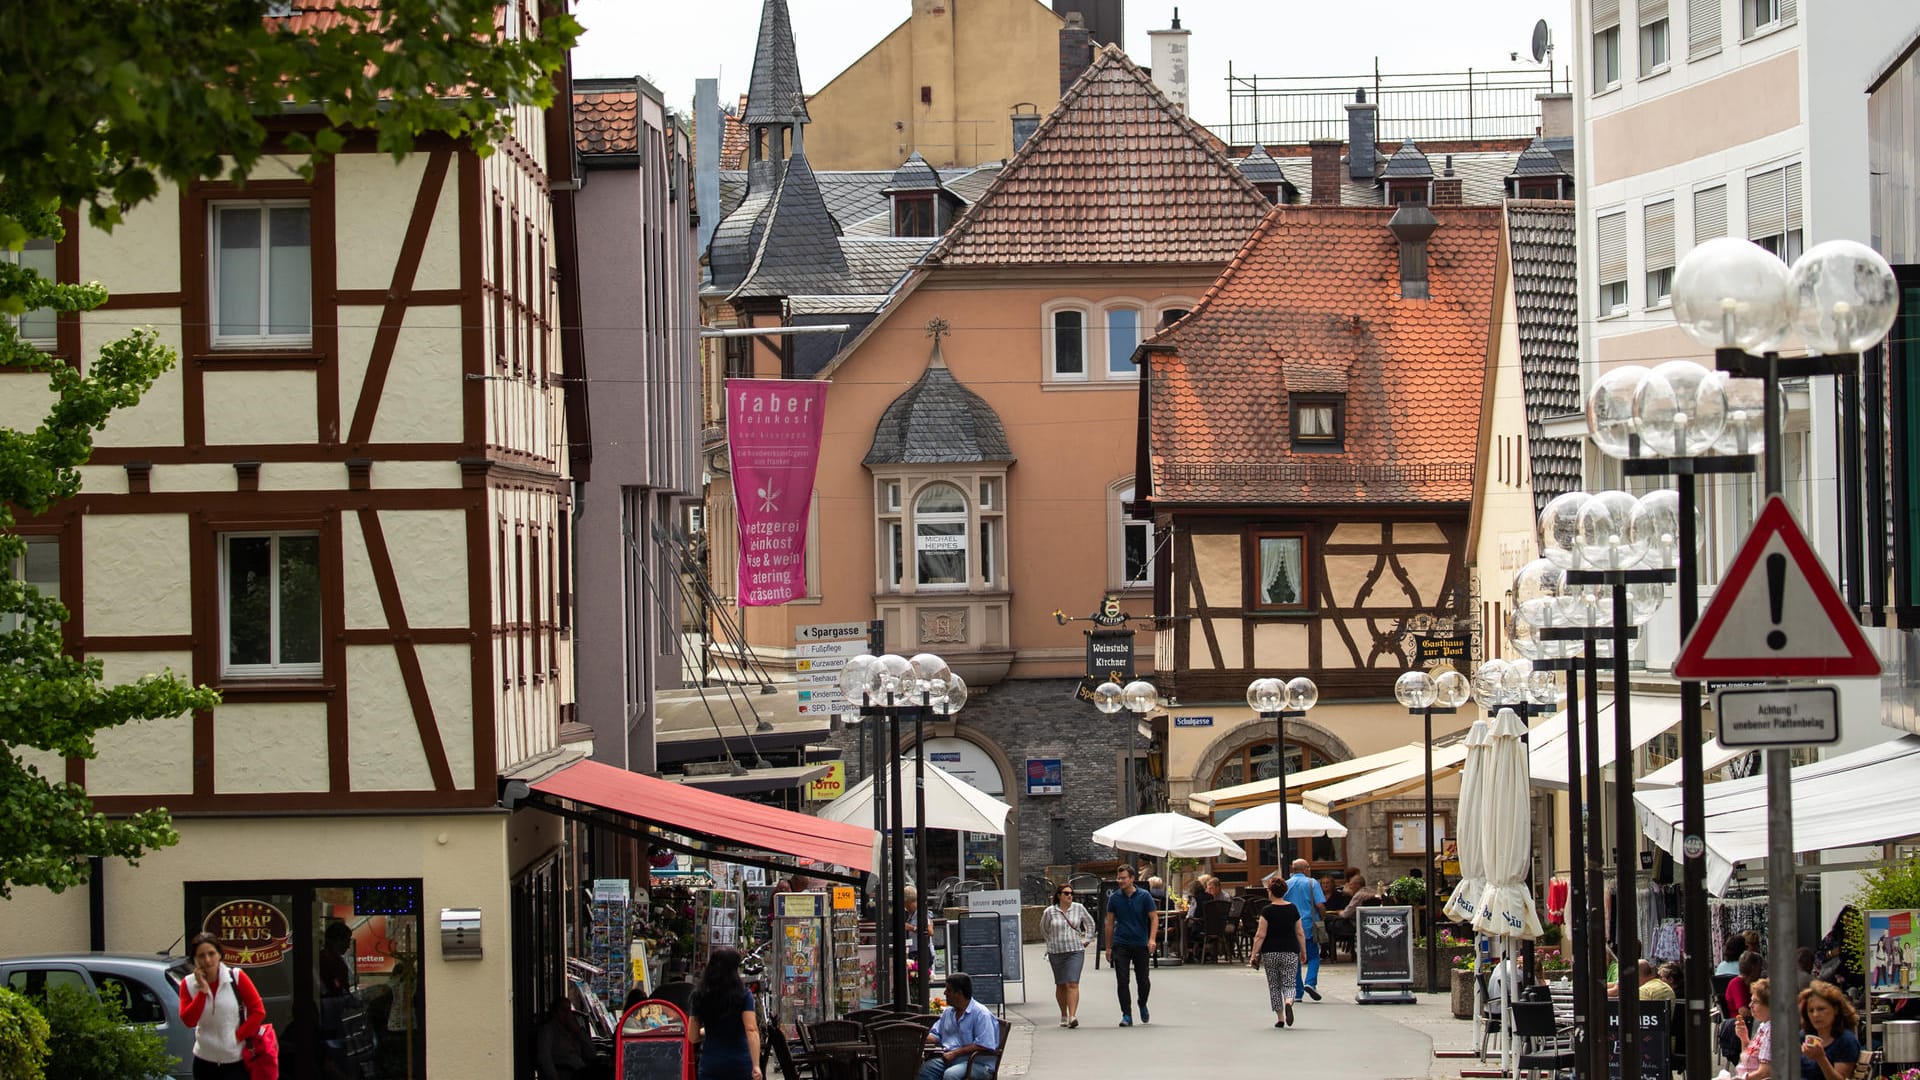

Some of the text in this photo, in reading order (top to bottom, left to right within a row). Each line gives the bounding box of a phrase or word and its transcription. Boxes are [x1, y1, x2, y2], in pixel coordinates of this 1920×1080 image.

[739, 392, 813, 413] faber
[739, 414, 807, 424] feinkost
[763, 552, 771, 567] &
[773, 551, 800, 567] wein
[752, 568, 792, 585] atering
[811, 627, 860, 639] Spargasse
[1092, 643, 1129, 653] Weinstube
[1422, 639, 1464, 648] Gasthaus
[811, 644, 842, 654] Fußpflege
[1443, 646, 1463, 657] Post
[811, 659, 844, 668] Kurzwaren
[1096, 657, 1127, 667] Kirchner
[811, 674, 838, 683] Teehaus
[811, 704, 826, 713] SPD
[1758, 704, 1791, 716] Achtung
[1176, 717, 1210, 726] Schulgasse
[1733, 718, 1825, 730] unebener Plattenbelag
[991, 898, 1018, 907] angebote
[1455, 892, 1474, 914] bräu
[221, 915, 272, 928] KEBAP
[1366, 916, 1402, 925] TROPICS
[221, 927, 272, 941] HAUS
[223, 949, 280, 961] ner Pizza
